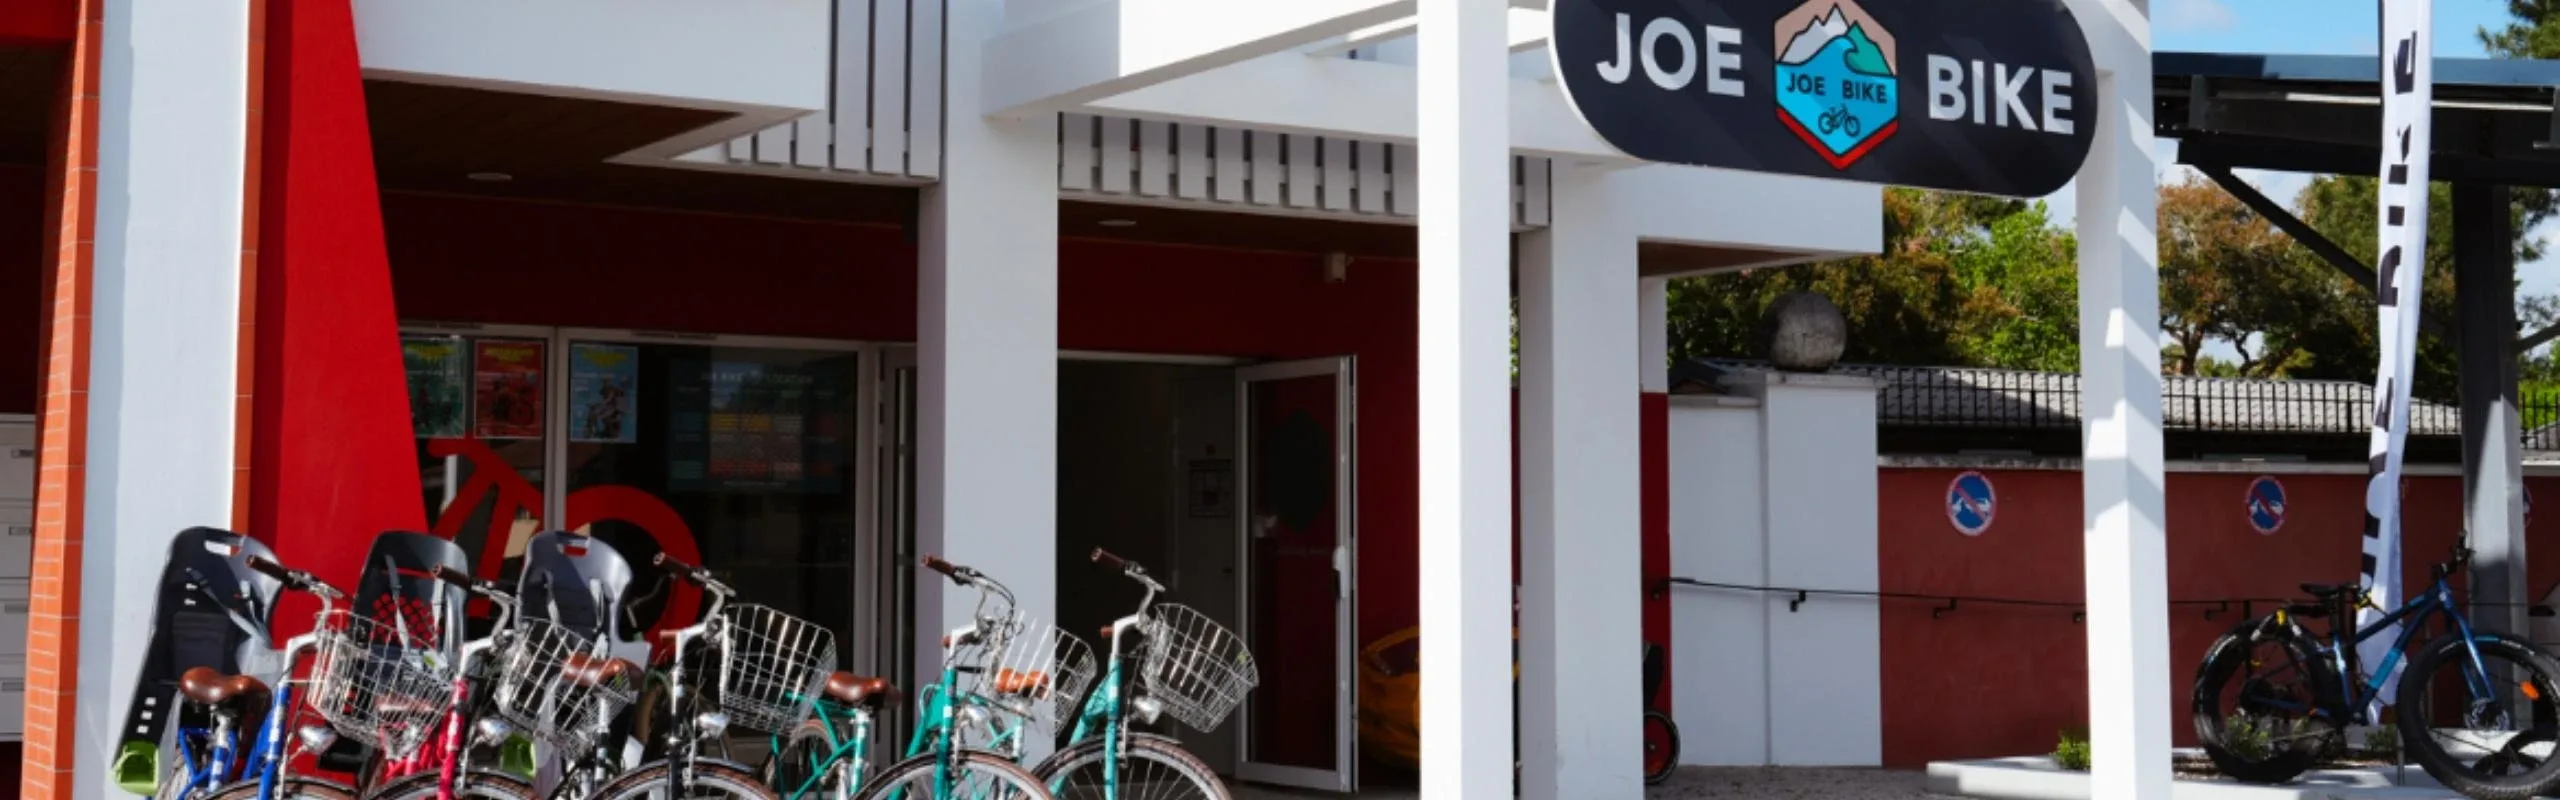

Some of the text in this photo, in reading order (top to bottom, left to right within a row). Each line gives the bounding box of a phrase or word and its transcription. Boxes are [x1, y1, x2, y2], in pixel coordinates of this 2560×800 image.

[1596, 12, 2075, 135] JOE BIKE
[1786, 72, 1888, 105] JOE BIKE
